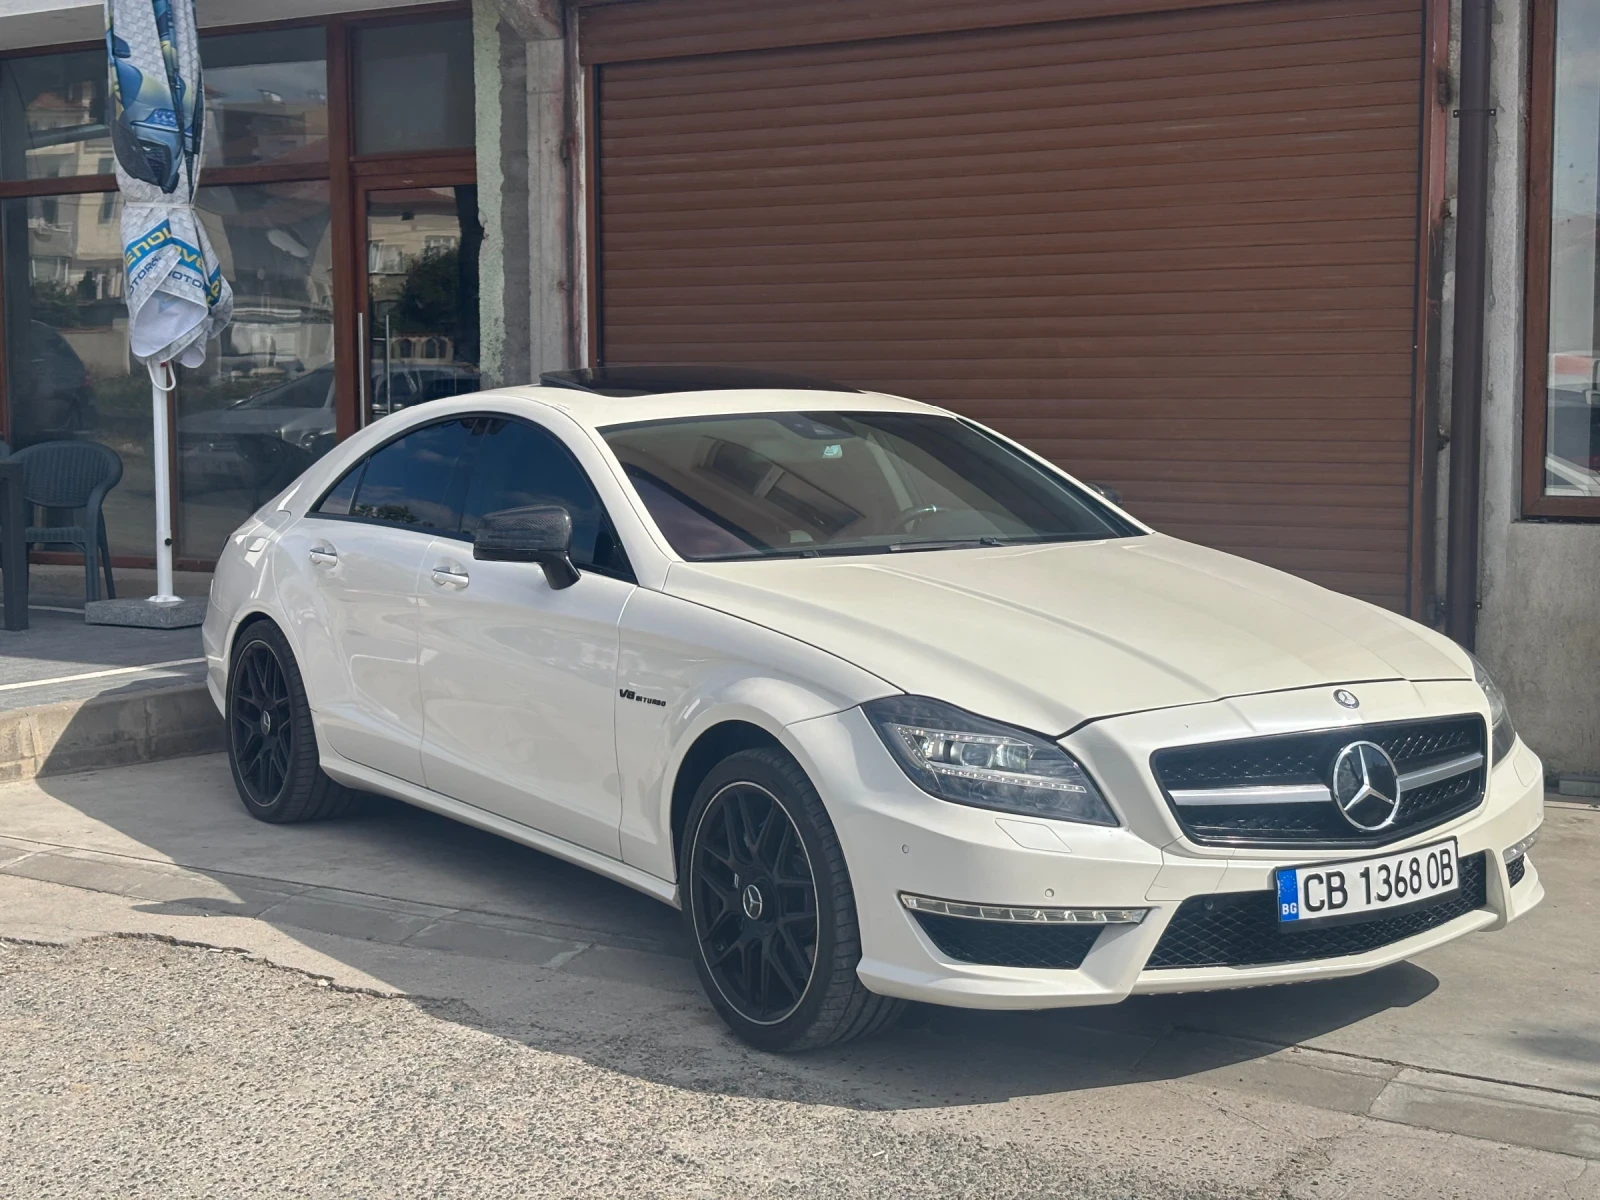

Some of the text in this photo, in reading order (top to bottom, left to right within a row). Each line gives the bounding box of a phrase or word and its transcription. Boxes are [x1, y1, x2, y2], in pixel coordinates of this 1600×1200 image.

[125, 227, 172, 266] ENOL
[619, 688, 636, 700] V8
[1303, 870, 1348, 912] CB
[1359, 857, 1422, 905] 1368
[1282, 902, 1298, 915] BG
